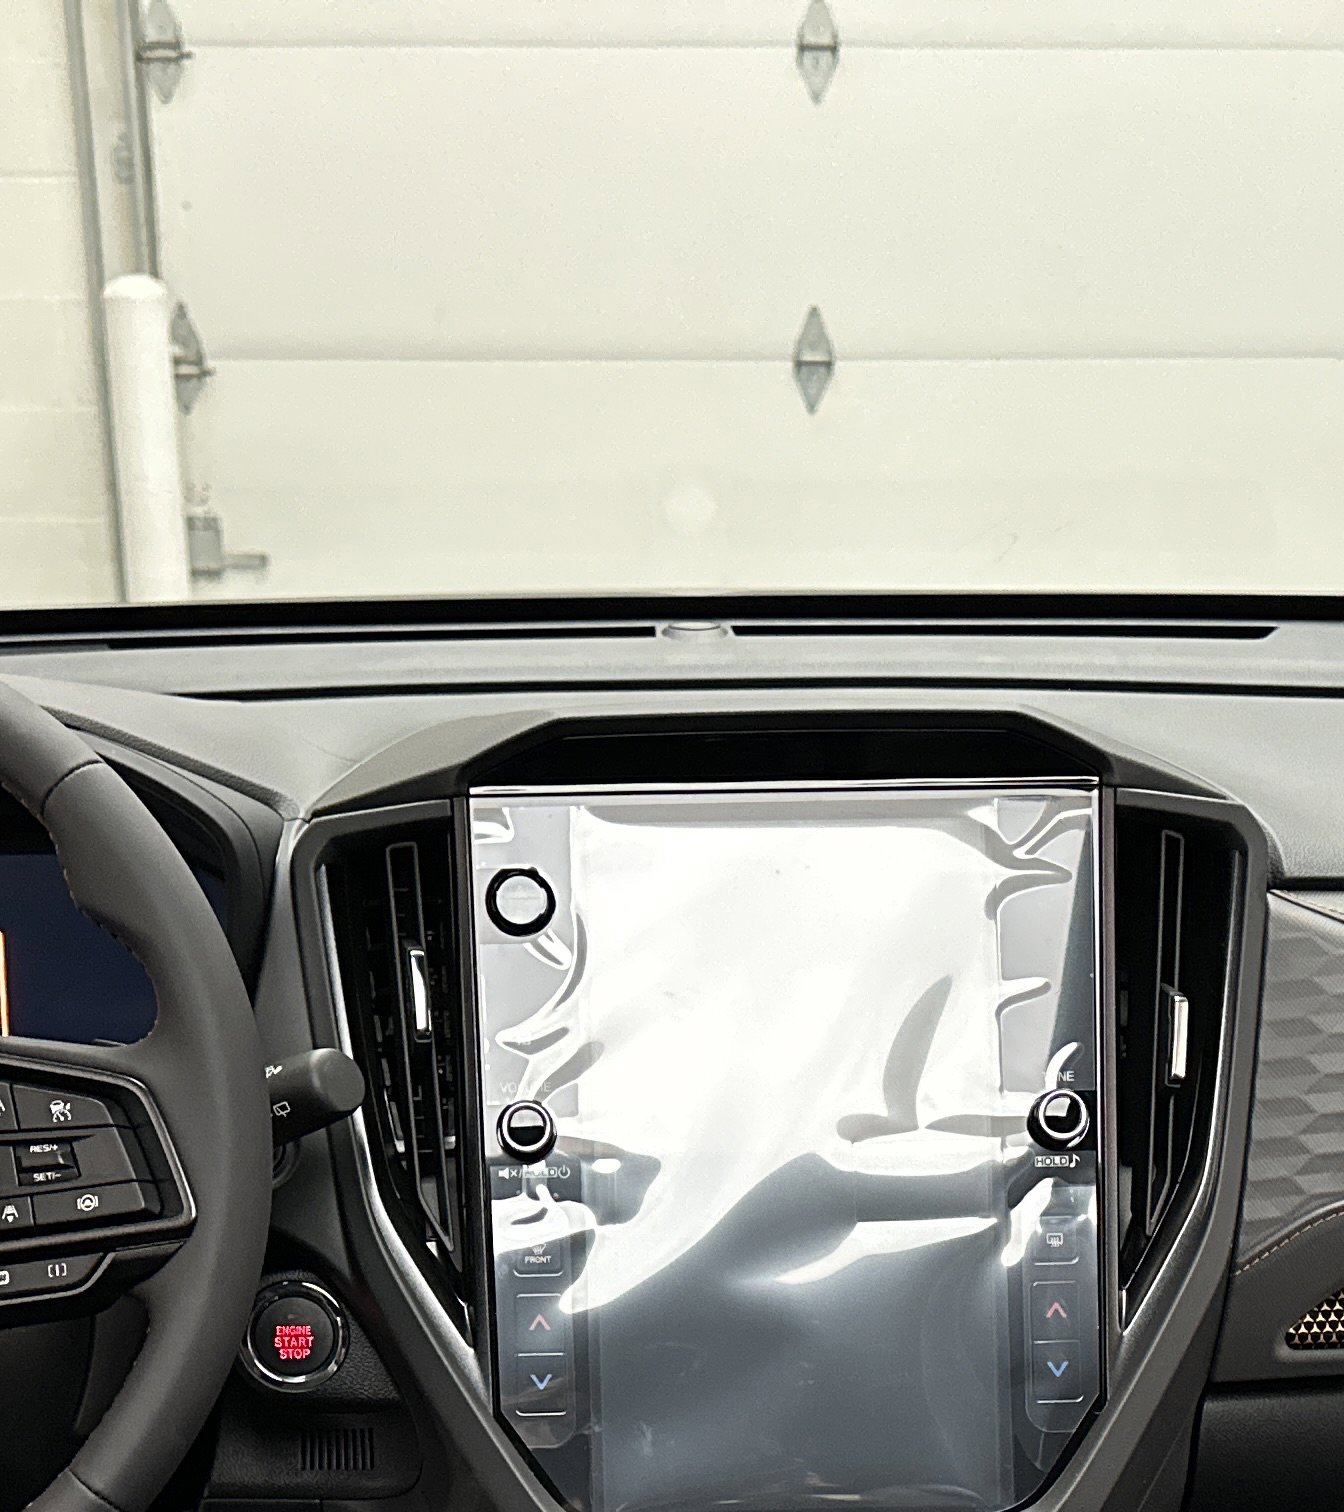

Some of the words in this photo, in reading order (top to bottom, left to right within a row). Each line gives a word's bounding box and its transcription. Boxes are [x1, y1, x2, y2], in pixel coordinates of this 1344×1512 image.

[1035, 1156, 1068, 1166] HOLD
[525, 1256, 552, 1264] FRONT
[276, 1325, 312, 1335] ENGINE
[274, 1336, 314, 1347] START
[279, 1348, 311, 1359] STOP
